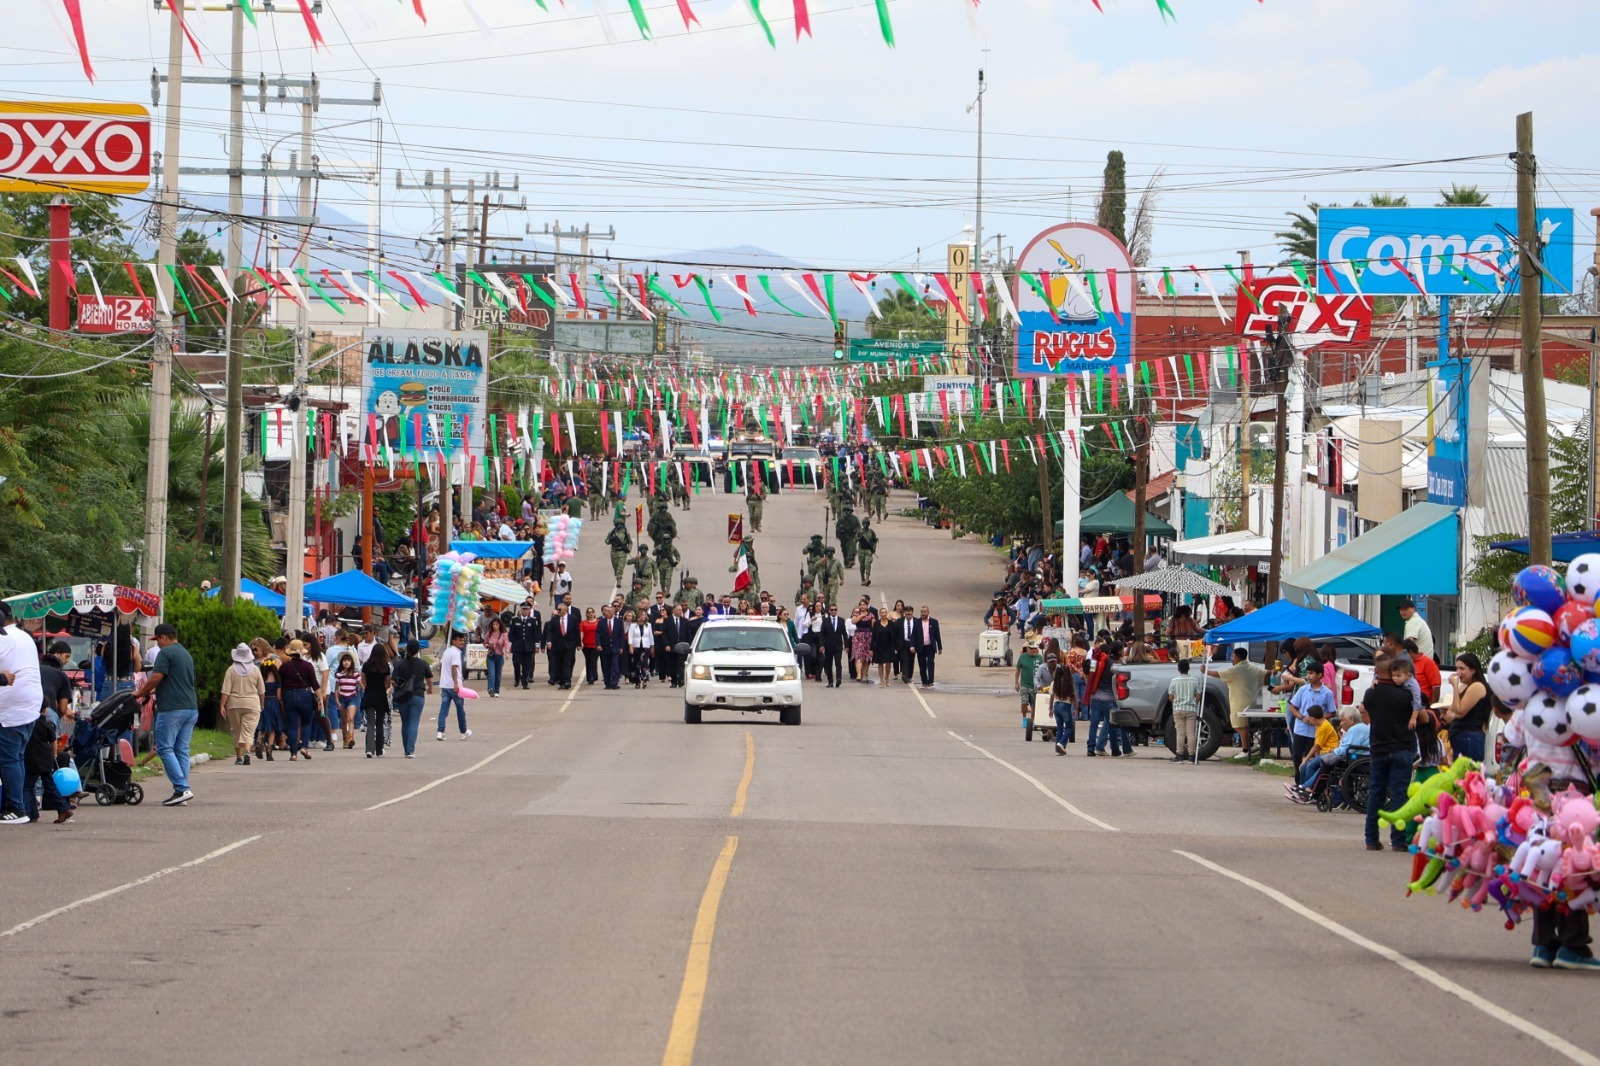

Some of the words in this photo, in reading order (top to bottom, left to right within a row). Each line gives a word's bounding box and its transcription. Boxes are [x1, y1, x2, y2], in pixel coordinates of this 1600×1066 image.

[116, 300, 151, 321] 24
[874, 341, 909, 349] AVENIDA
[367, 336, 483, 367] ALASKA
[1066, 362, 1113, 371] MARISCOS
[449, 370, 476, 380] GAMES
[433, 395, 480, 403] HAMBURGUESAS
[31, 586, 73, 612] NIEVE
[85, 585, 103, 594] DE
[1085, 604, 1120, 613] GARRAFA
